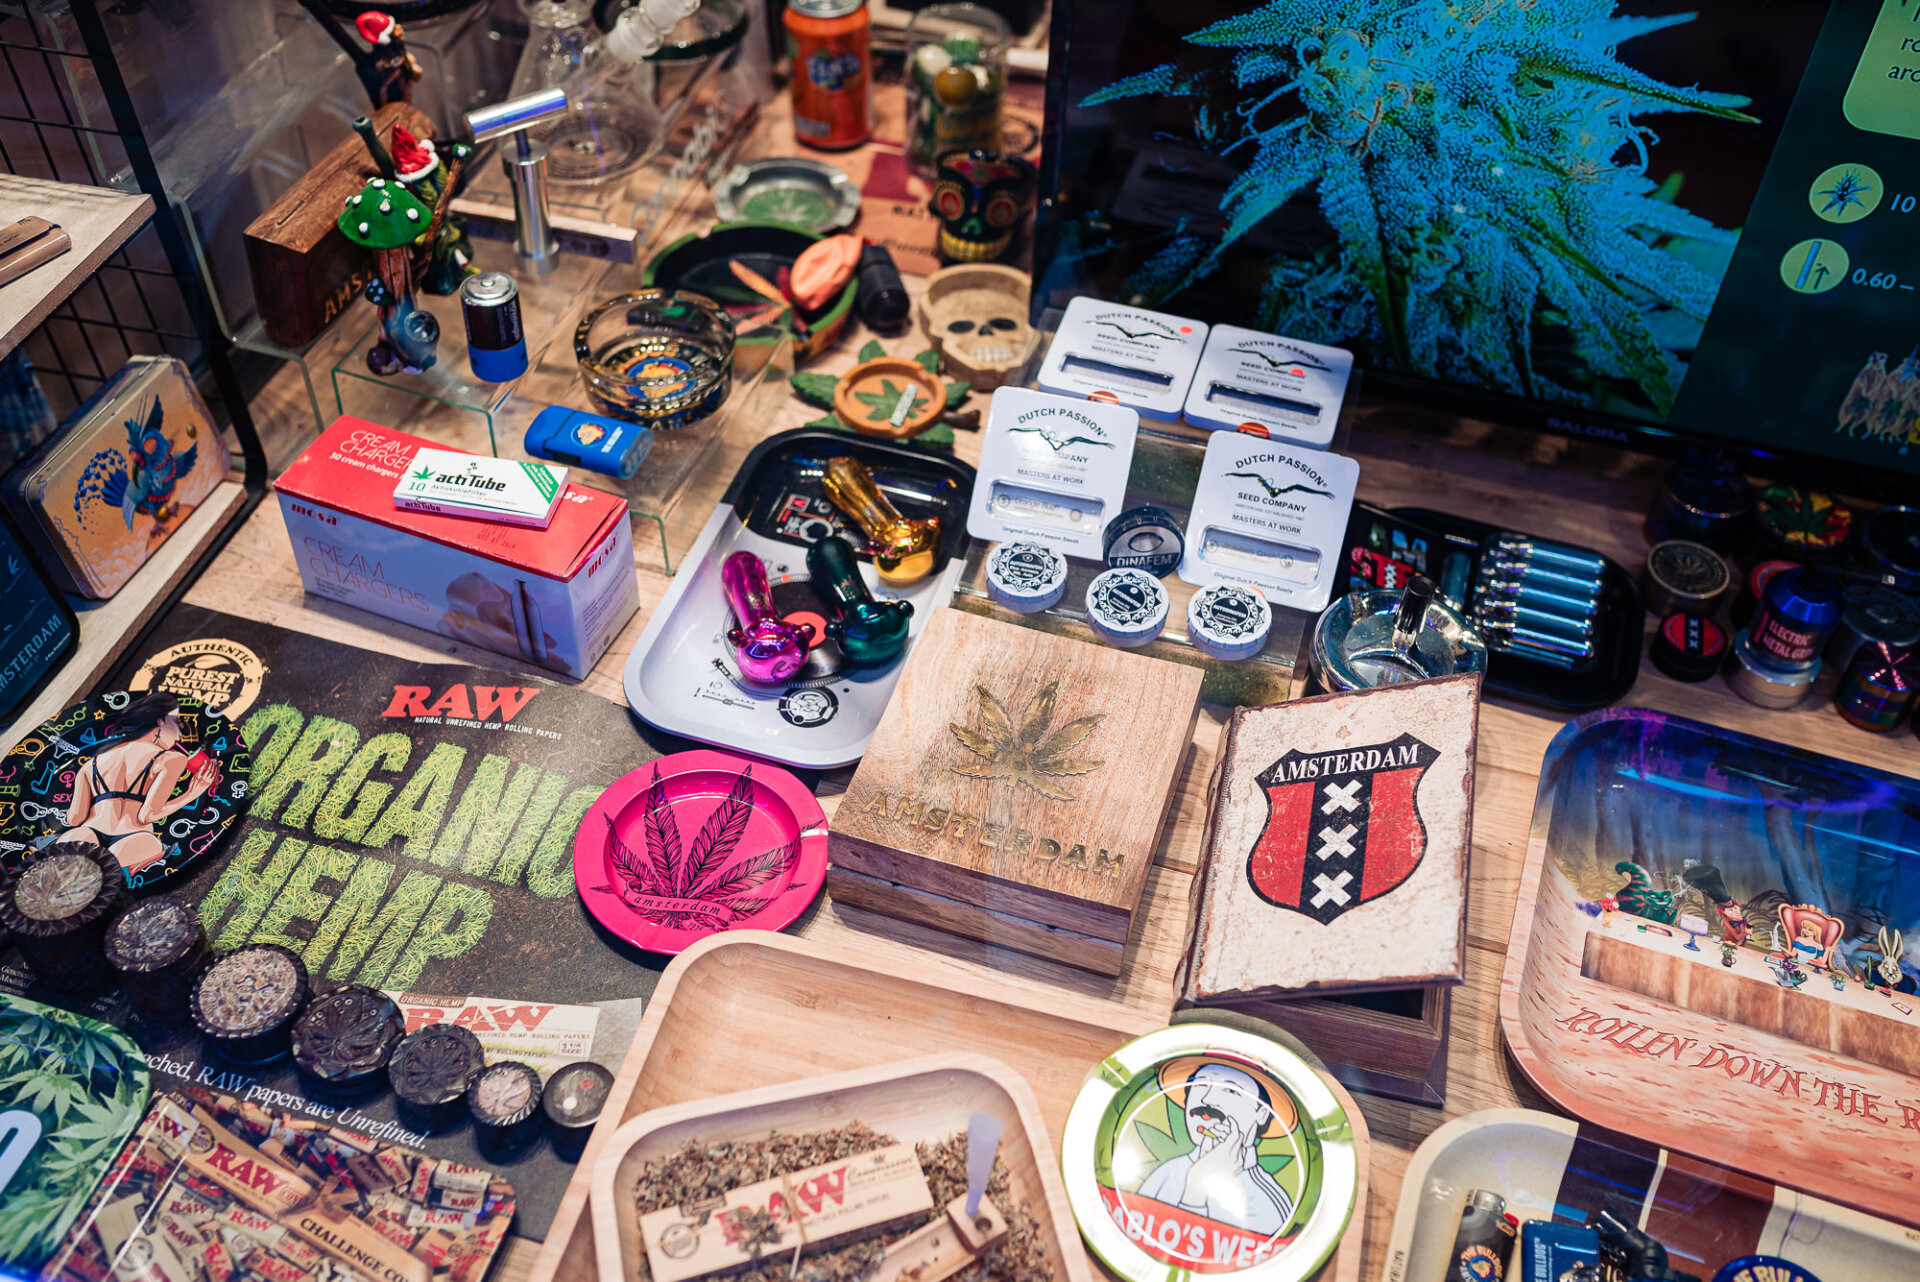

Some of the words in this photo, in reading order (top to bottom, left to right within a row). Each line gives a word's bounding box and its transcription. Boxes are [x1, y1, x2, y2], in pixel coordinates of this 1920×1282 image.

[1891, 194, 1916, 213] 10
[1852, 268, 1897, 290] 0.60
[1018, 408, 1056, 424] DUTCH
[1059, 408, 1104, 437] PASSION
[350, 430, 413, 456] CREAM
[329, 451, 342, 461] 50
[341, 456, 366, 469] cream
[366, 463, 400, 479] chargers
[1235, 453, 1275, 469] DUTCH
[1278, 454, 1324, 487] PASSION
[408, 481, 427, 493] 10
[1237, 491, 1260, 503] SEED
[1262, 497, 1308, 513] COMPANY
[1232, 513, 1266, 527] MASTERS
[1268, 521, 1278, 529] AT
[1280, 523, 1302, 535] WORK
[303, 536, 385, 581] CREAM
[309, 556, 431, 612] CHARGERS
[0, 612, 62, 692] MSTERDAM
[170, 641, 256, 668] AUTHENTIC
[162, 675, 233, 694] NATURAL
[168, 665, 241, 684] PUREST
[380, 683, 541, 723] RAW
[414, 716, 443, 725] NATURAL
[446, 717, 483, 729] UNREFINED
[484, 721, 502, 730] HEMP
[504, 724, 533, 735] ROLLING
[536, 728, 563, 740] PAPERS
[1270, 743, 1420, 785] AMSTERDAM
[52, 793, 73, 803] SEX
[240, 702, 608, 900] ORGANIC
[863, 792, 1126, 878] AMSTERDAM
[200, 826, 497, 993] HEMP
[634, 894, 721, 915] amsterdam
[400, 995, 438, 1006] ORGANIC
[440, 998, 465, 1008] HEMP
[404, 1004, 556, 1034] RAW
[1555, 1005, 1698, 1062] ROLLIN'
[1688, 1043, 1806, 1100] DOWN
[1810, 1076, 1889, 1125] THE
[196, 1065, 250, 1093] RAW
[243, 1081, 305, 1111] papers
[305, 1098, 336, 1120] are
[336, 1106, 431, 1150] Unrefined.
[205, 1142, 288, 1196] RAW
[300, 1217, 386, 1274] CHALLENGE
